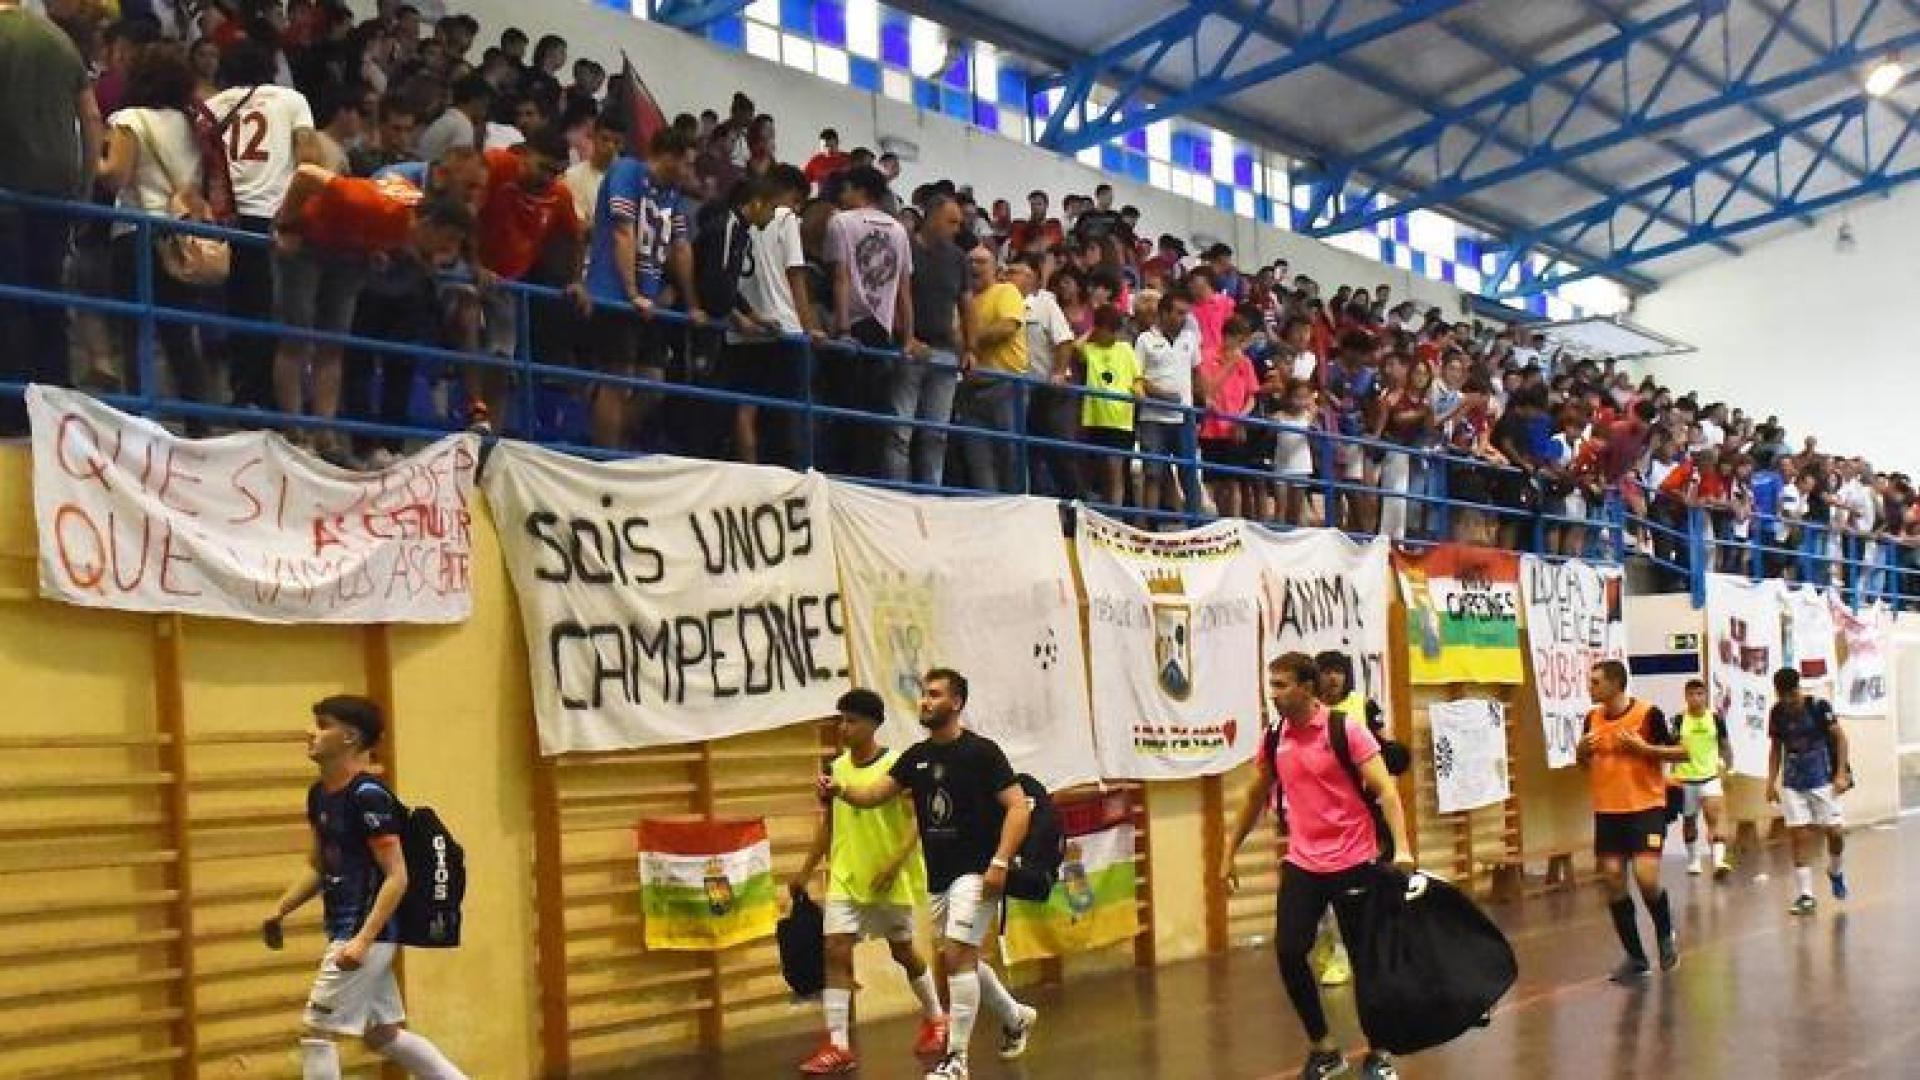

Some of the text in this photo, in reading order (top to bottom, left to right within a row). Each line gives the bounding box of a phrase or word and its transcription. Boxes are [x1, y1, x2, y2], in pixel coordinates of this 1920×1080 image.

[229, 110, 269, 162] 12
[57, 413, 203, 518] QUE
[228, 458, 289, 530] SI
[55, 504, 202, 597] QUE
[689, 497, 813, 576] UNOS
[549, 592, 852, 711] CAMPEONES
